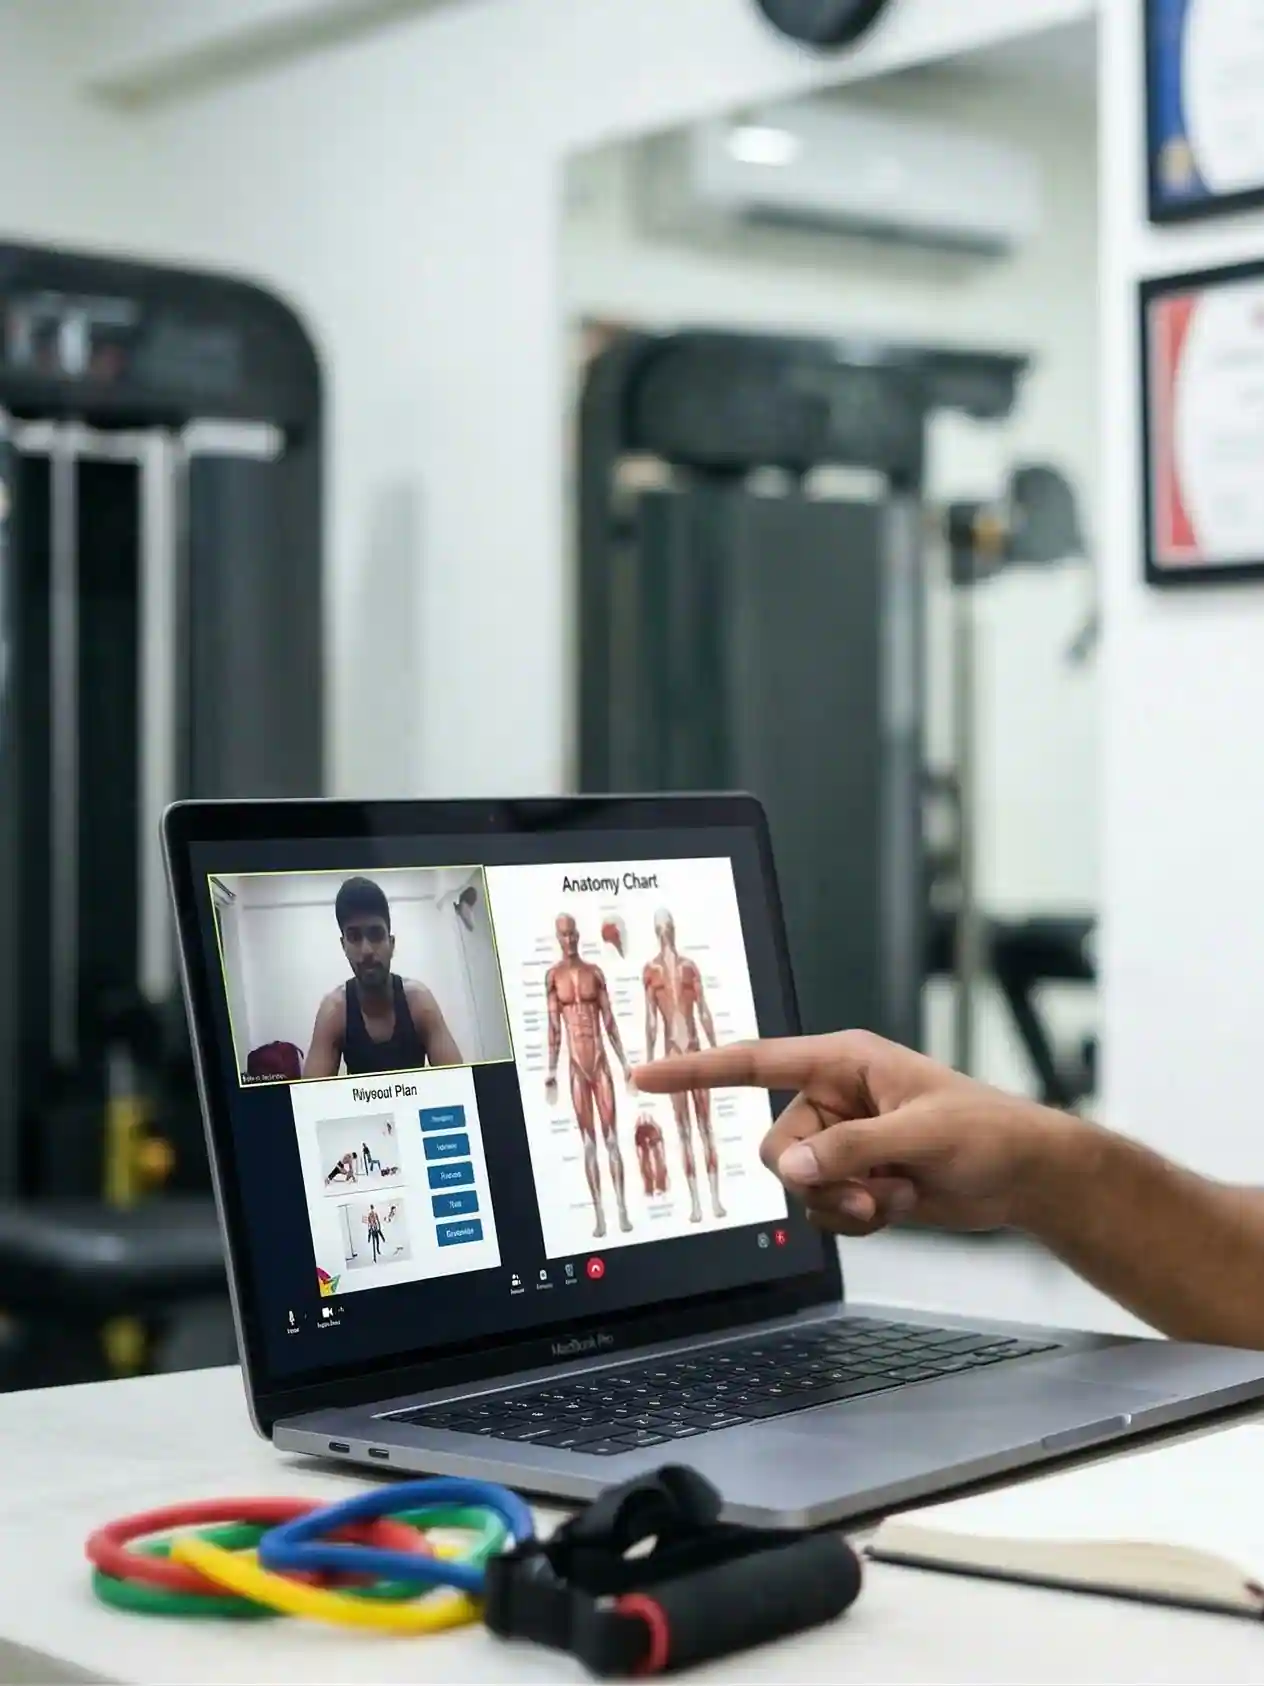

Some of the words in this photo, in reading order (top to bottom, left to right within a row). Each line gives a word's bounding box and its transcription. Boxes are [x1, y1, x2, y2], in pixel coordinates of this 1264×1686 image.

[562, 875, 620, 895] Anatomy
[623, 872, 658, 890] Chart
[394, 1084, 418, 1097] Plan
